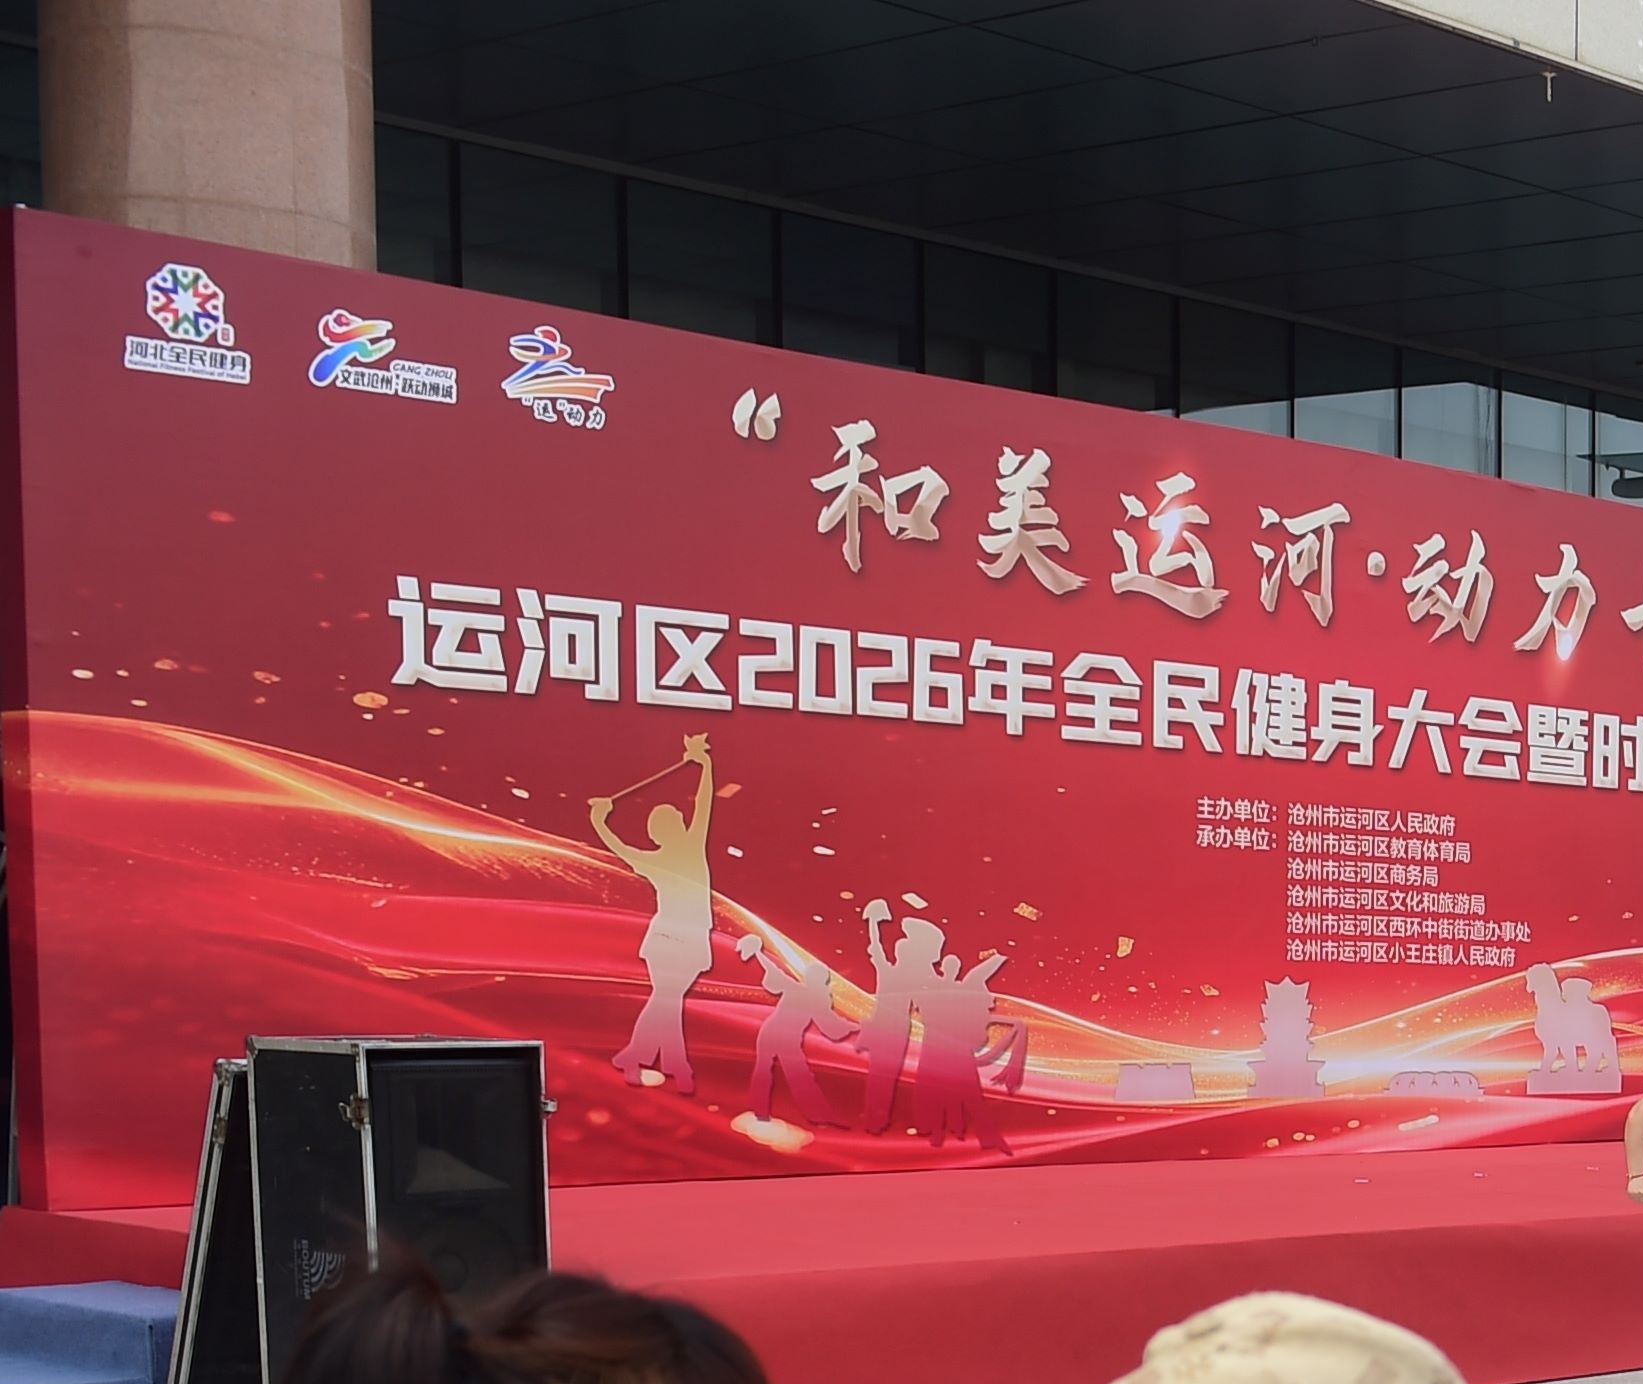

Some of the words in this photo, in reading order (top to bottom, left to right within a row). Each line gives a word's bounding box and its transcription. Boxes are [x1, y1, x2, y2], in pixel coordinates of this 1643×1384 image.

[129, 339, 248, 373] 河北全民健身
[392, 362, 422, 376] CANG
[424, 366, 454, 380] ZHOU
[1286, 857, 1440, 888] 沧州市运河区商务局
[1286, 884, 1487, 916] 沧州市运河区文化和旅游局
[1286, 911, 1532, 945] 沧州市运河区西环中街街道办事处
[1285, 938, 1517, 969] 沧州市运河区小王庄镇人民政府
